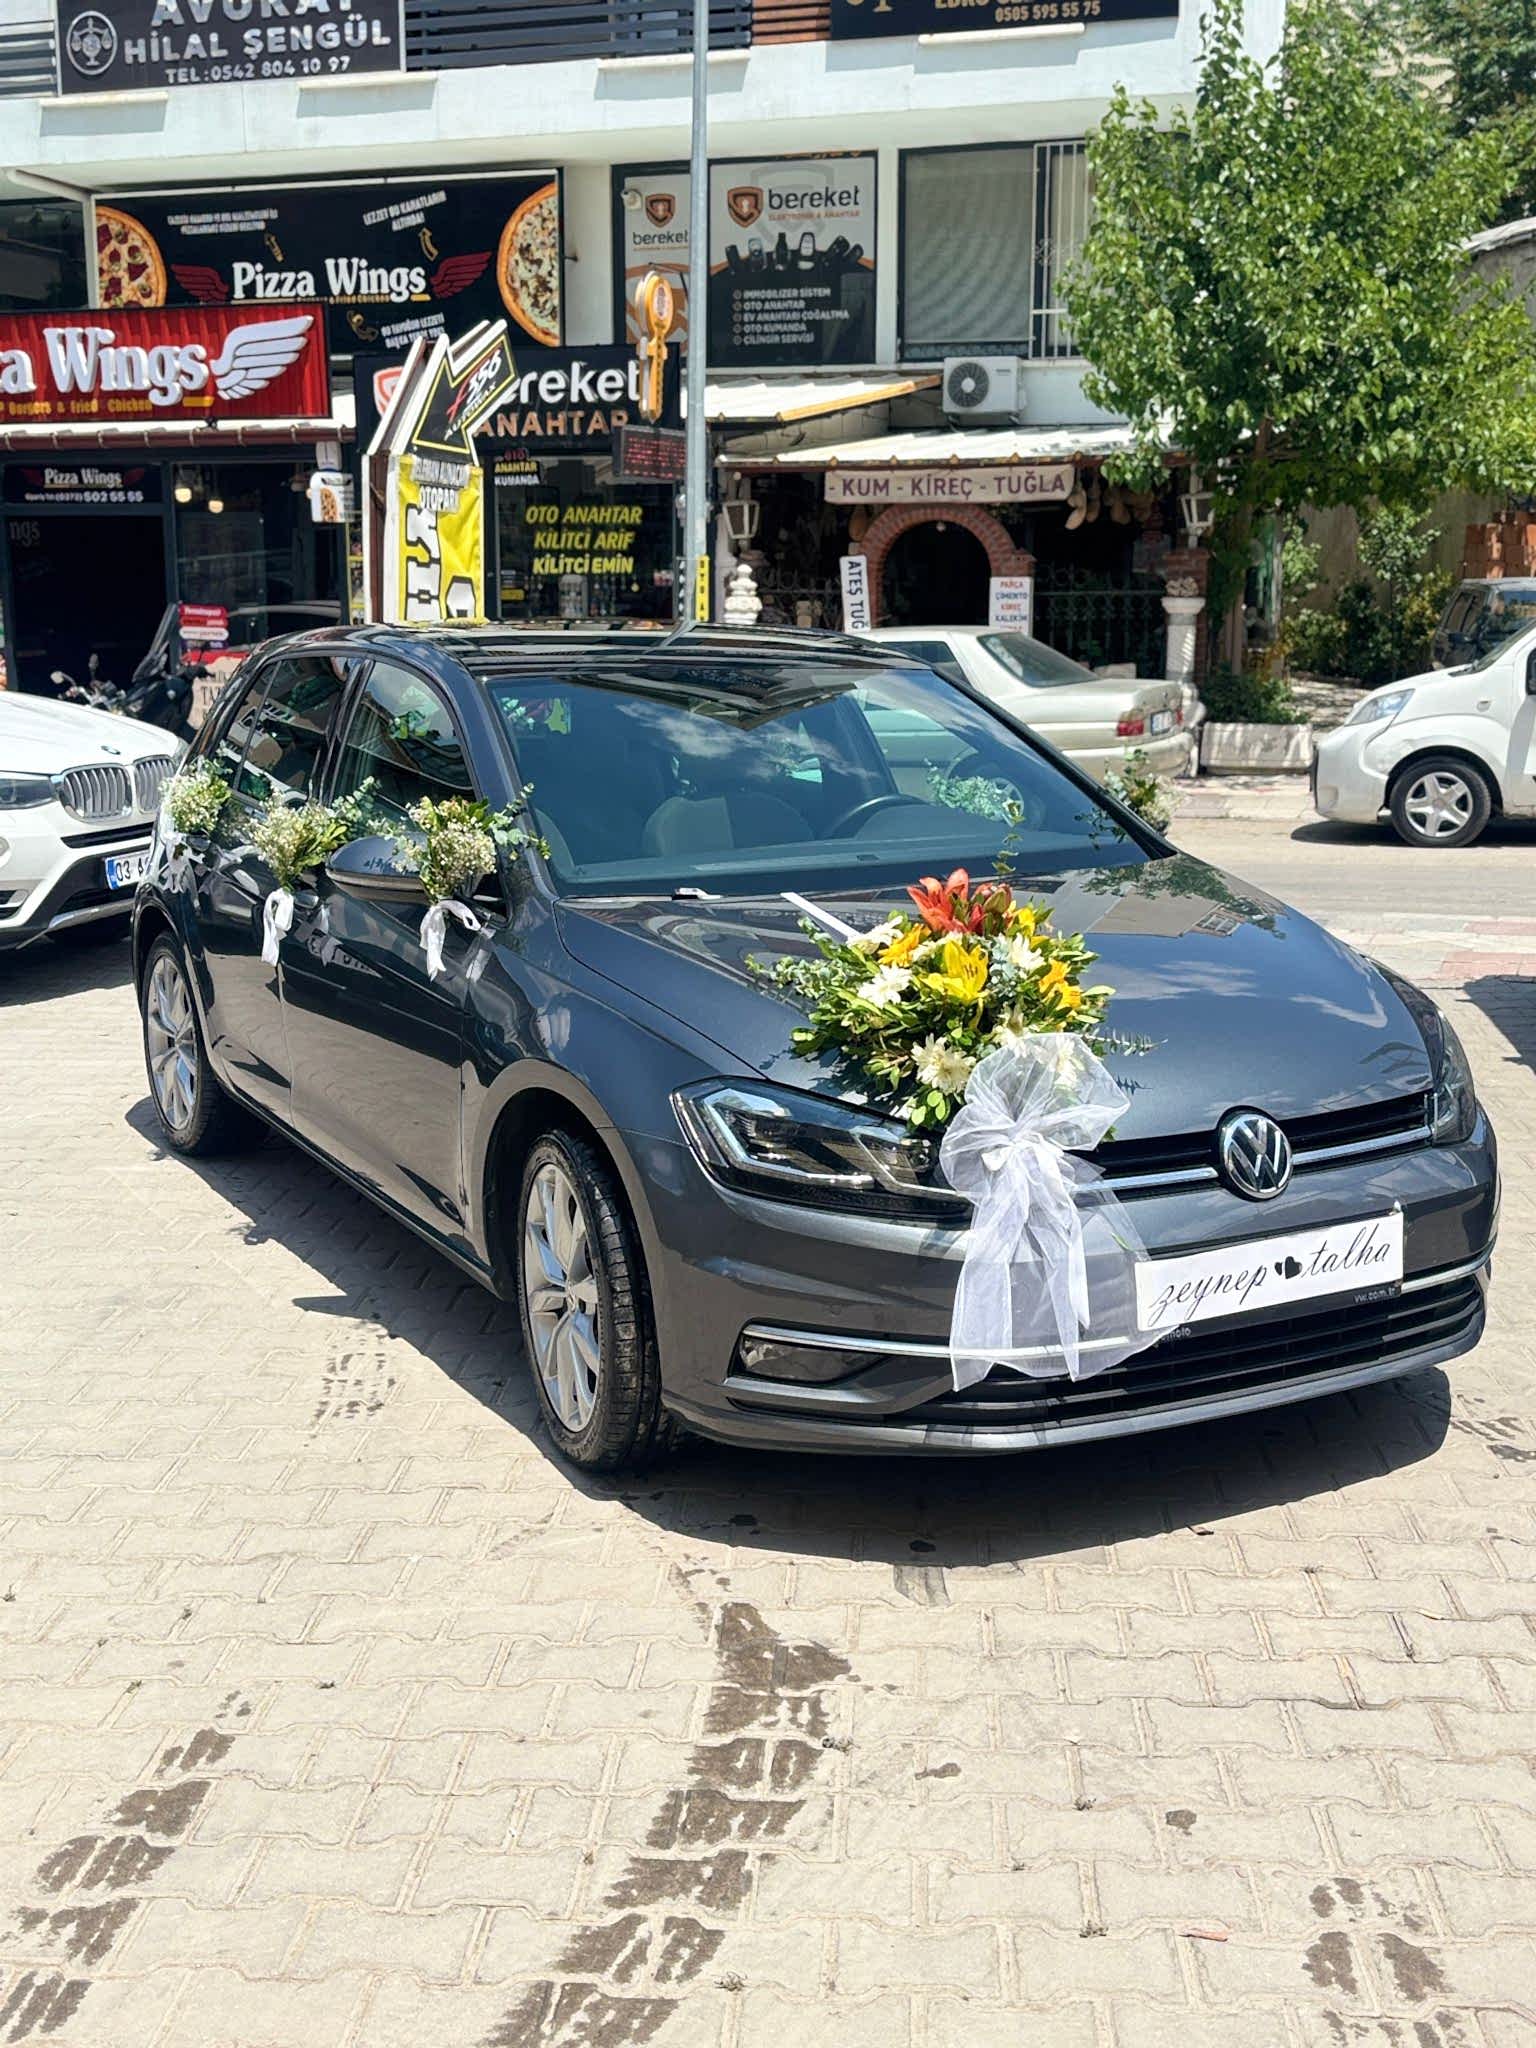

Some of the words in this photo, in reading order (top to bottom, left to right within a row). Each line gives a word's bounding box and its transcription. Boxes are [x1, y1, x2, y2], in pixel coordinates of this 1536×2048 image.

[1032, 4, 1058, 20] 595
[1061, 2, 1080, 18] 55
[1083, 1, 1101, 16] 75
[124, 31, 229, 64] HİLAL
[243, 13, 391, 60] ŞENGÜL
[261, 59, 295, 78] 804
[302, 57, 321, 74] 10
[329, 55, 351, 72] 97
[768, 185, 860, 210] bereket
[632, 229, 688, 245] bereket
[232, 261, 316, 299] Pizza
[324, 257, 427, 303] Wings
[43, 327, 210, 406] Wings
[44, 467, 79, 485] Pizza
[80, 467, 123, 488] Wings
[493, 460, 538, 473] ANAHTAR
[841, 478, 891, 497] KUM
[911, 474, 973, 500] KİREÇ
[993, 471, 1066, 495] TUĞLA
[525, 505, 560, 525] OTO
[562, 505, 644, 525] ANAHTAR
[533, 528, 591, 550] KİLİTCİ
[593, 529, 636, 550] ARİF
[532, 553, 591, 574] KİLİTCİ
[591, 553, 634, 574] EMİN
[847, 560, 864, 596] ATEŞ
[115, 860, 131, 882] 03
[1147, 1264, 1268, 1328] zeynep
[1301, 1223, 1391, 1279] talha
